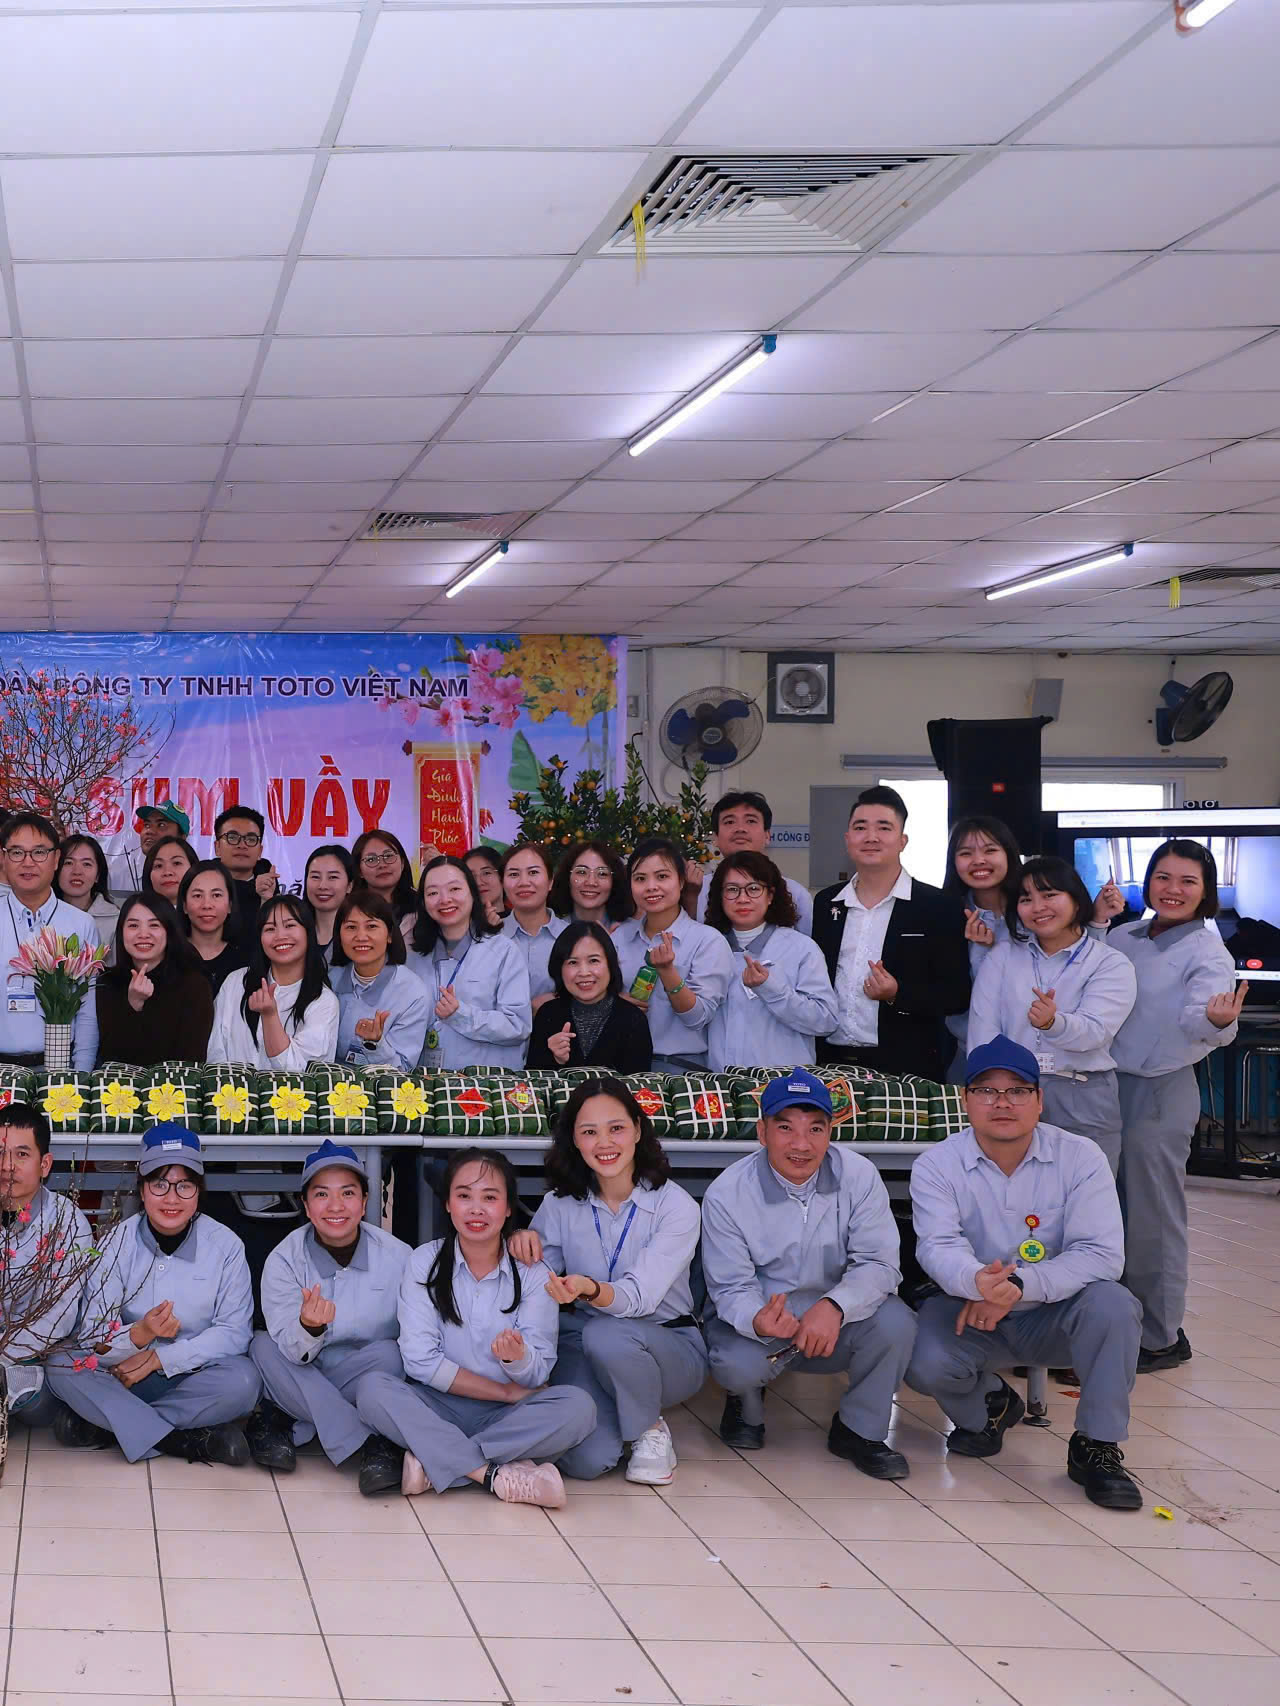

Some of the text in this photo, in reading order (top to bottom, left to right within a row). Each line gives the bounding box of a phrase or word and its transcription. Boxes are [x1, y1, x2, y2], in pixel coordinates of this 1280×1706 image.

[54, 672, 131, 695] CÔNG
[139, 676, 173, 695] TY
[181, 676, 252, 696] TNHH
[261, 676, 334, 697] TOTO
[342, 673, 401, 701] VIỆT
[409, 677, 468, 697] NAM
[432, 768, 453, 783] Gia
[85, 777, 240, 837] SUM
[267, 755, 391, 837] VẦY
[427, 788, 461, 803] Đình
[431, 808, 464, 826] Hạnh
[429, 828, 461, 845] Phúc
[777, 831, 802, 842] CÔNG
